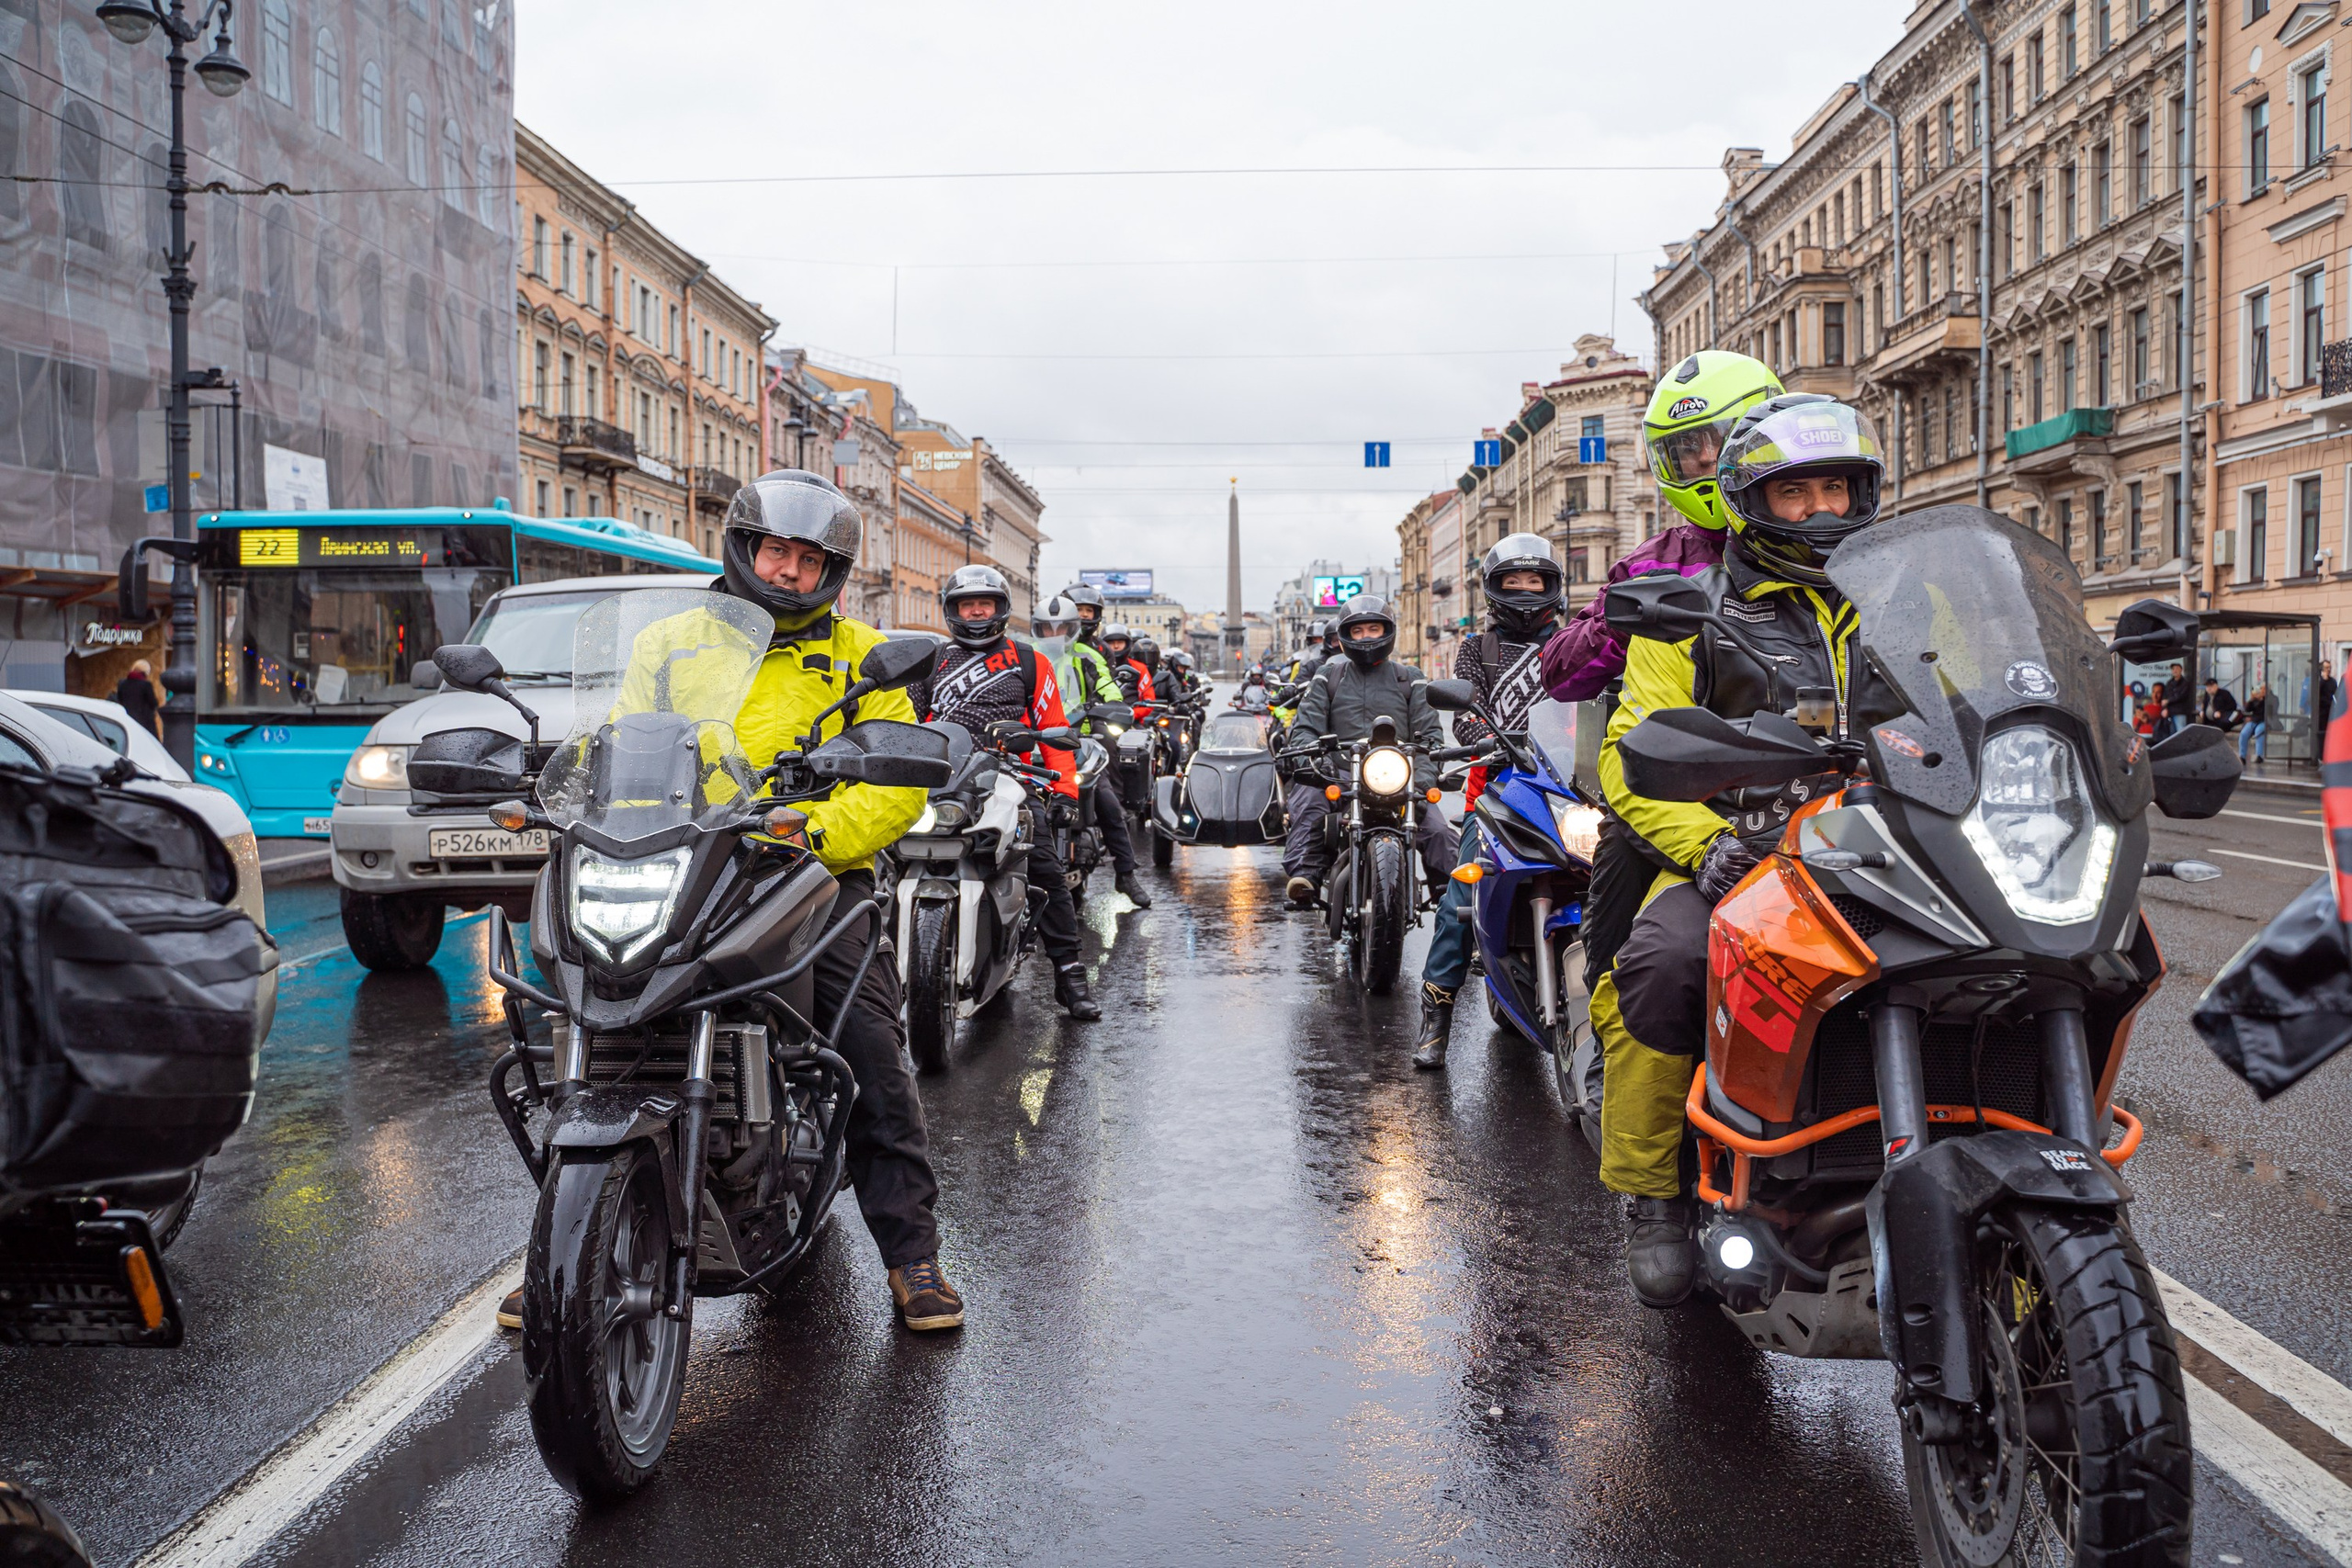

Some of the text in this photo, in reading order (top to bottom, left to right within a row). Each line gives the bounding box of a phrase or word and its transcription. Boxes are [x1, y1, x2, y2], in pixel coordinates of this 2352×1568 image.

[1669, 398, 1706, 417] Airoh
[1799, 430, 1843, 446] SHOEI
[256, 540, 280, 556] 22
[397, 541, 422, 555] ул.
[85, 622, 142, 646] Подружка
[2007, 669, 2016, 682] THE
[516, 831, 543, 846] 178
[2040, 1149, 2086, 1159] READY
[2051, 1161, 2093, 1171] RACE
